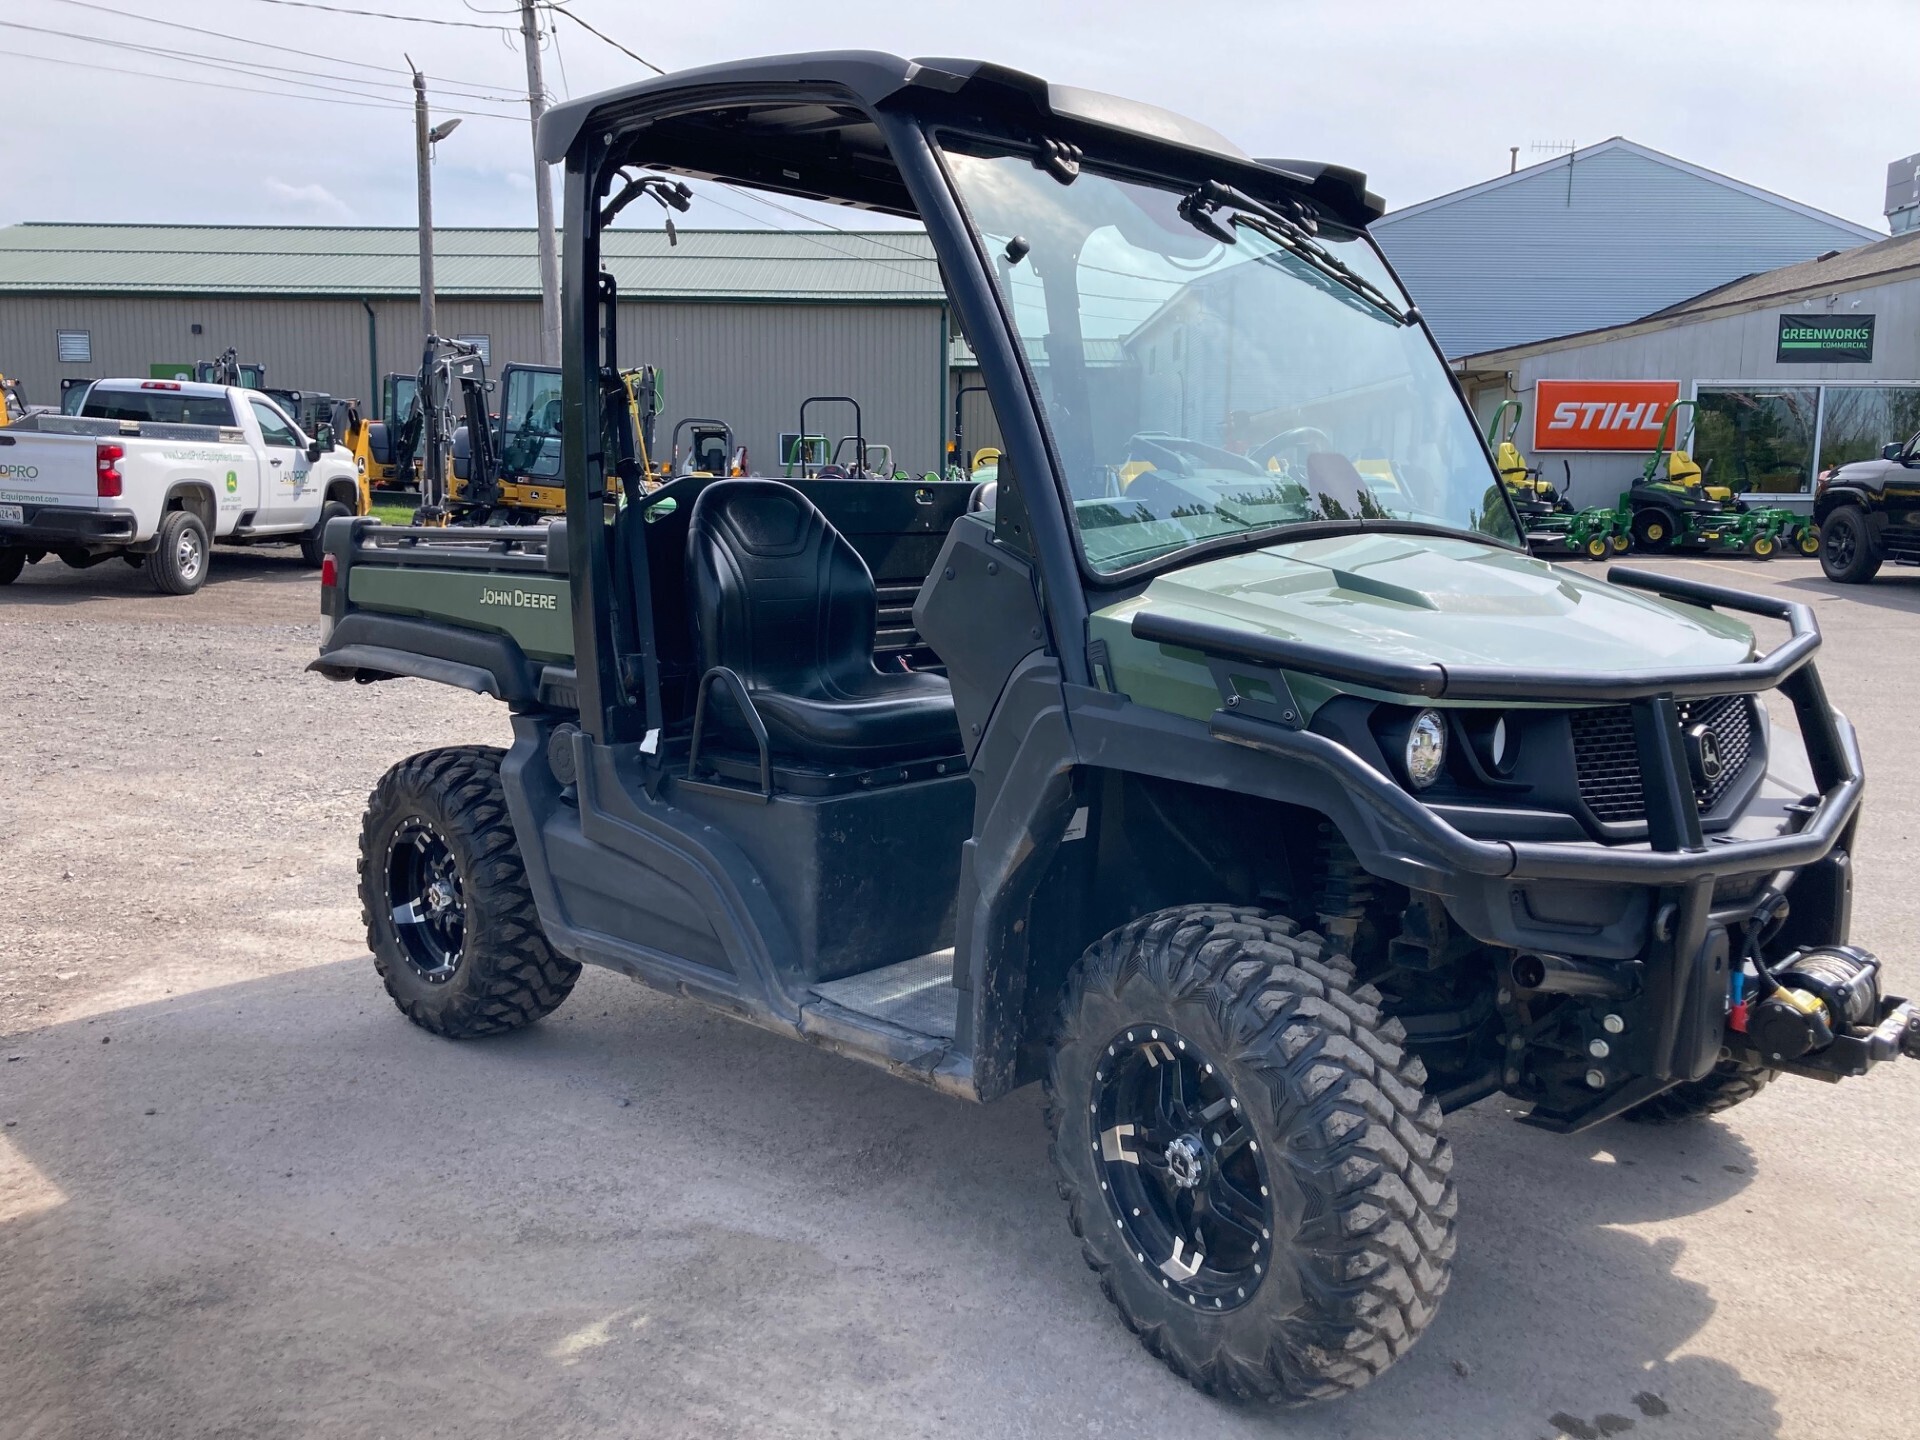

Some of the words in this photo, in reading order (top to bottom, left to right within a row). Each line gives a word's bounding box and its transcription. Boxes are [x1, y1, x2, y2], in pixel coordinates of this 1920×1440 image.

[1782, 328, 1869, 340] GREENWORKS
[1822, 341, 1868, 349] COMMERCIAL
[1547, 402, 1664, 430] STIHL
[280, 470, 310, 484] LANDPRO
[480, 587, 512, 606] JOHN
[514, 589, 557, 610] DEERE
